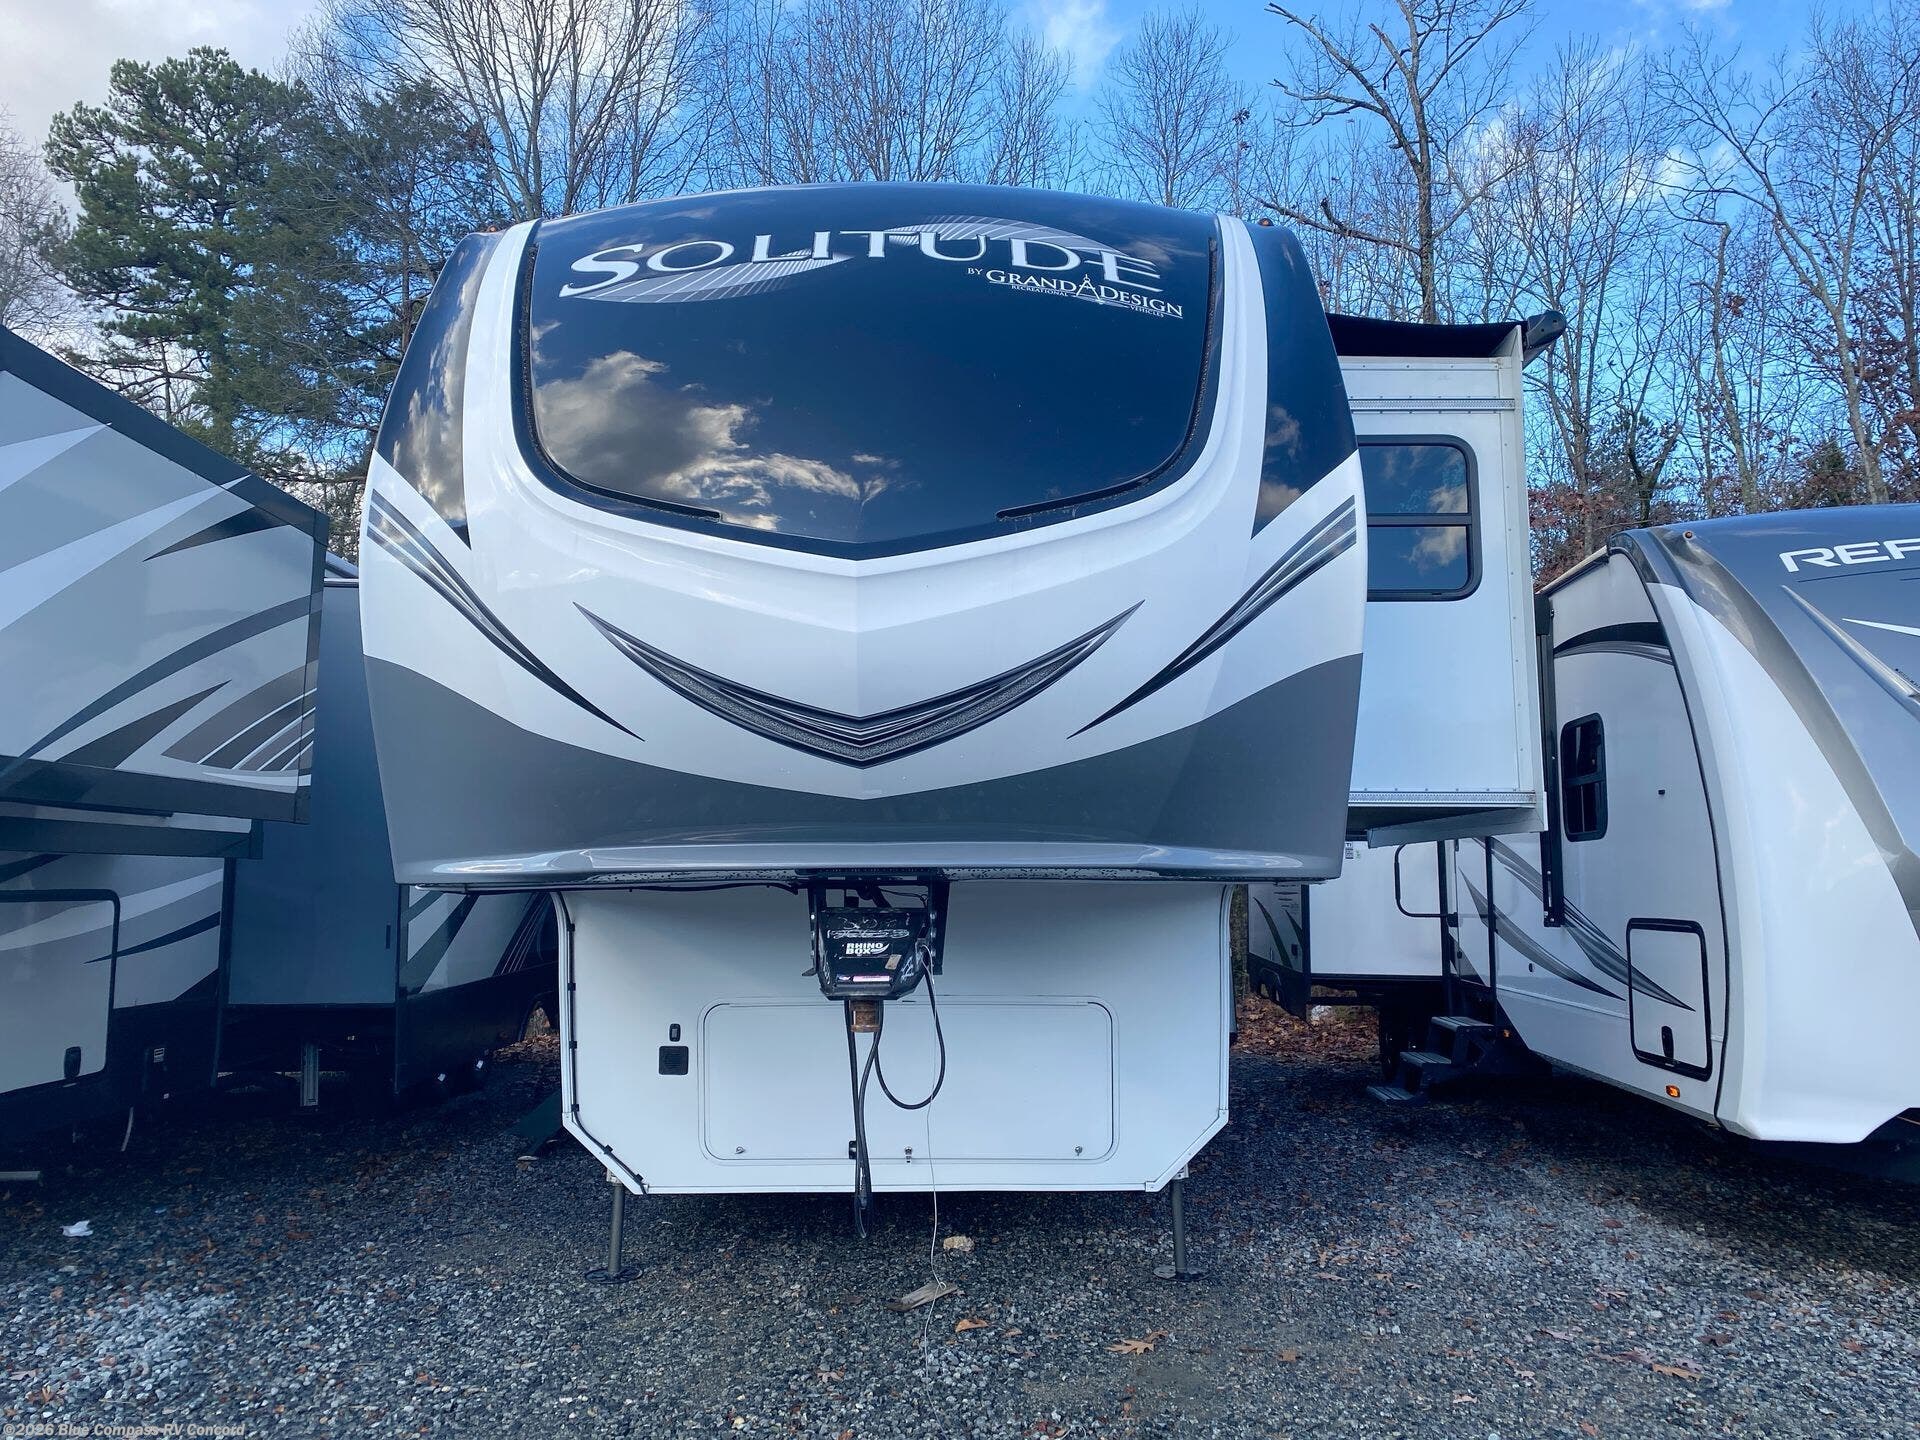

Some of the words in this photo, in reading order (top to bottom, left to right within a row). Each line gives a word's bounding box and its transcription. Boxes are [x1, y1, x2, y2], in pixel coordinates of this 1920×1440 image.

[558, 231, 1163, 297] SOLITUDE
[967, 267, 983, 275] BY
[985, 269, 1077, 292] GRAND
[1098, 285, 1183, 317] DESIGN
[1011, 284, 1069, 296] RECREATIONAL
